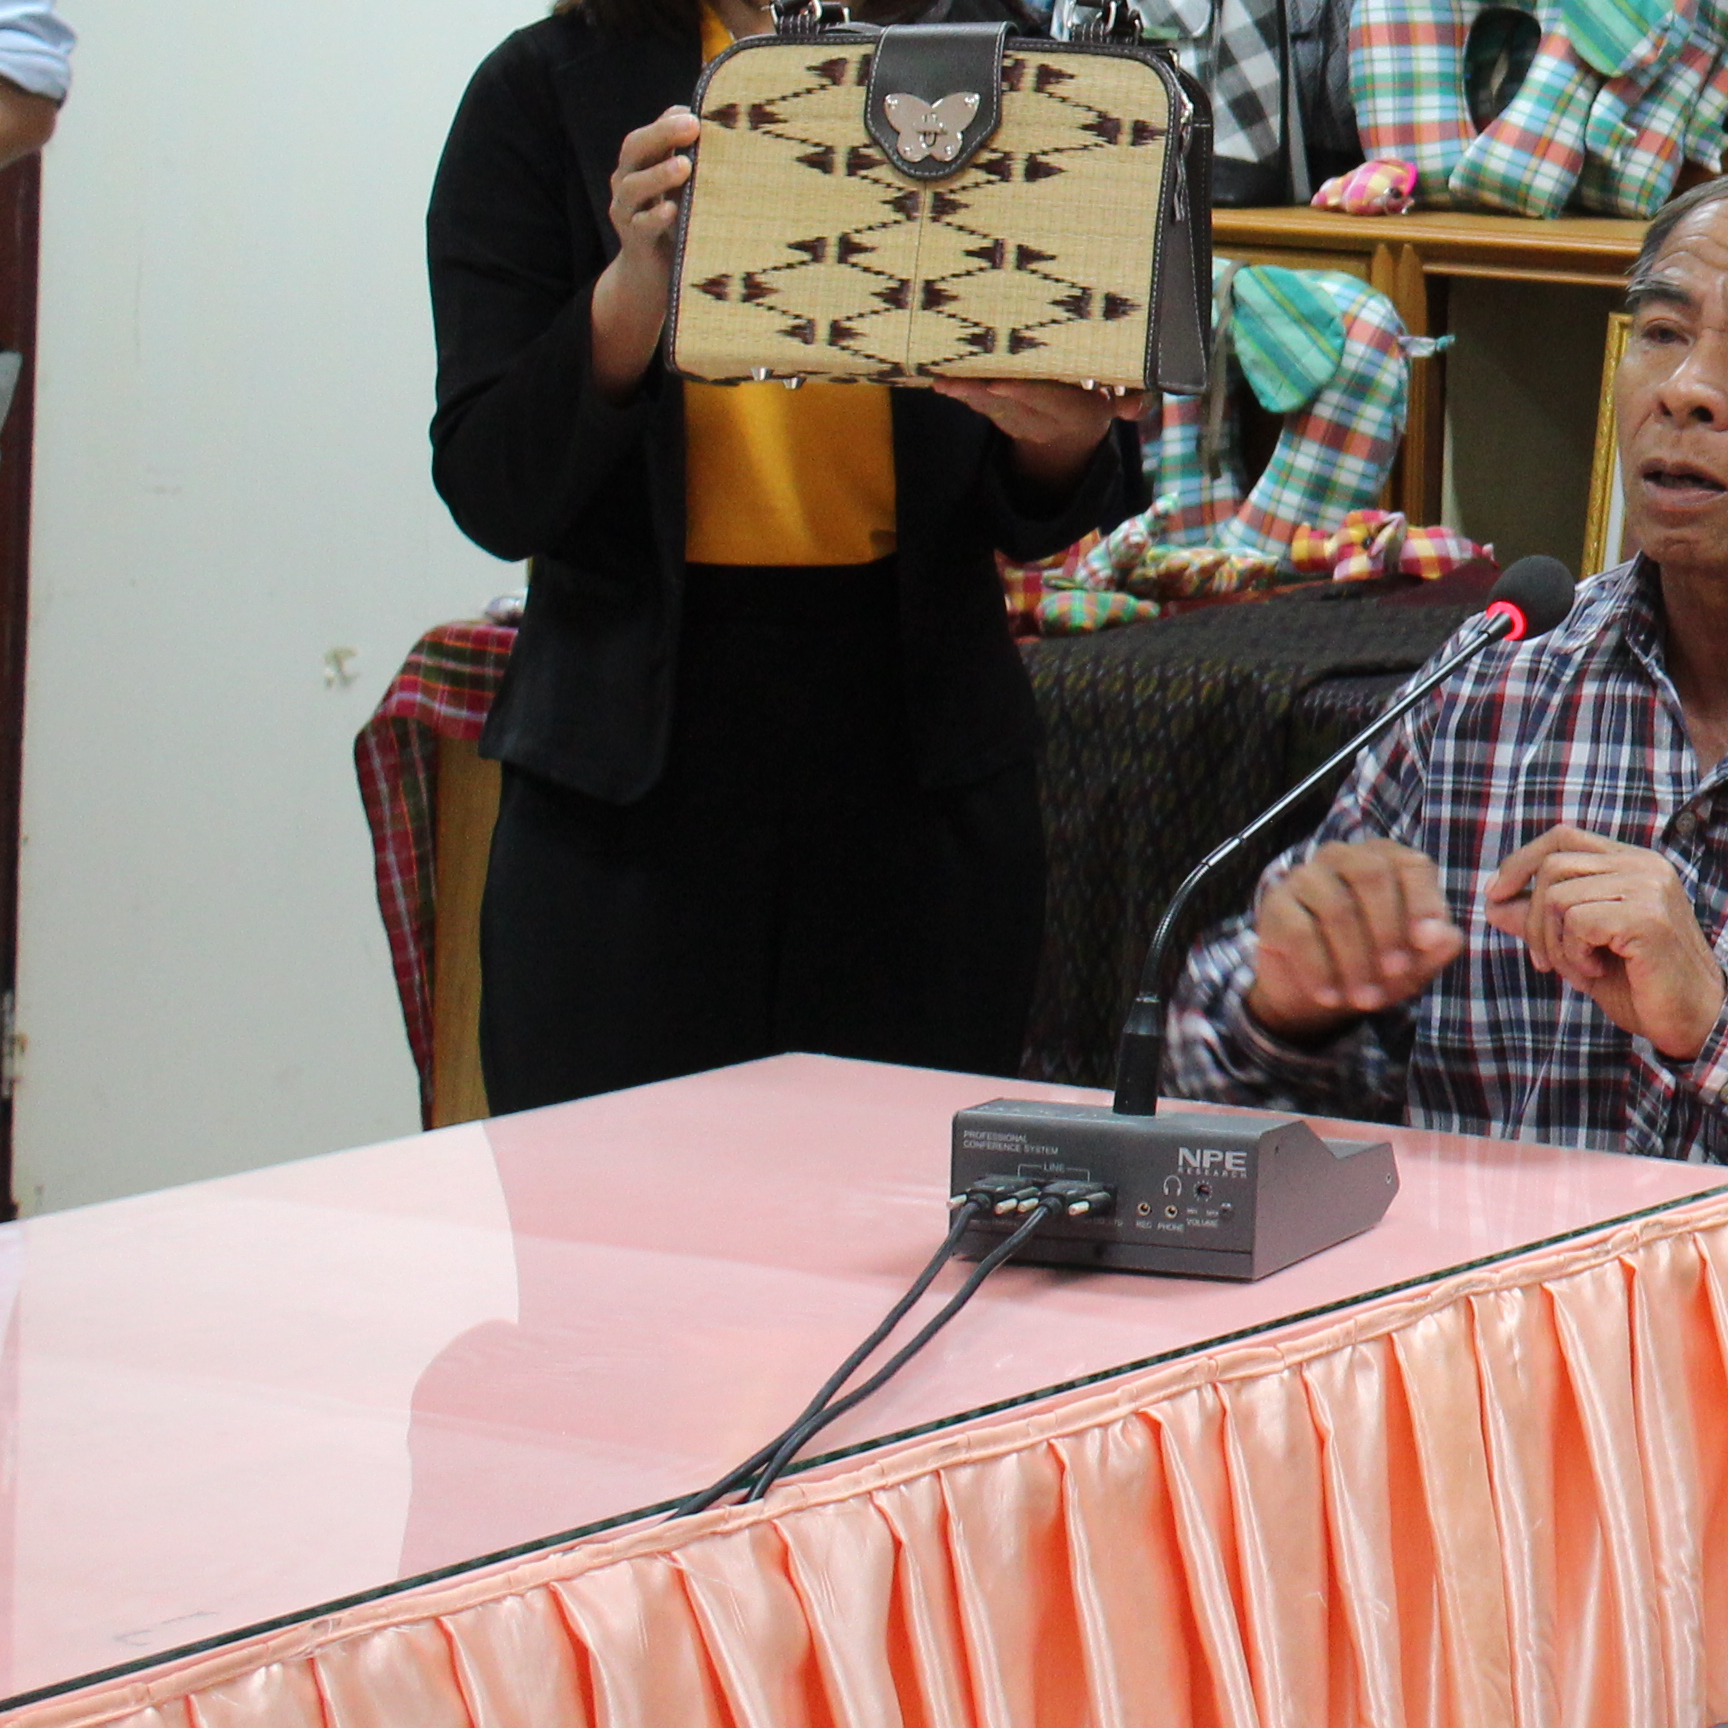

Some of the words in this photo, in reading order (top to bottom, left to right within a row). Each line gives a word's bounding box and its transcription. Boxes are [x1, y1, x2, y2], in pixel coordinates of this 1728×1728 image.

[963, 1130, 1027, 1143] PROFESSIONAL
[1024, 1144, 1059, 1154] SYSTEM
[1178, 1146, 1248, 1172] NPE
[1177, 1165, 1248, 1179] RESEARCH
[1157, 1221, 1184, 1232] PHONE
